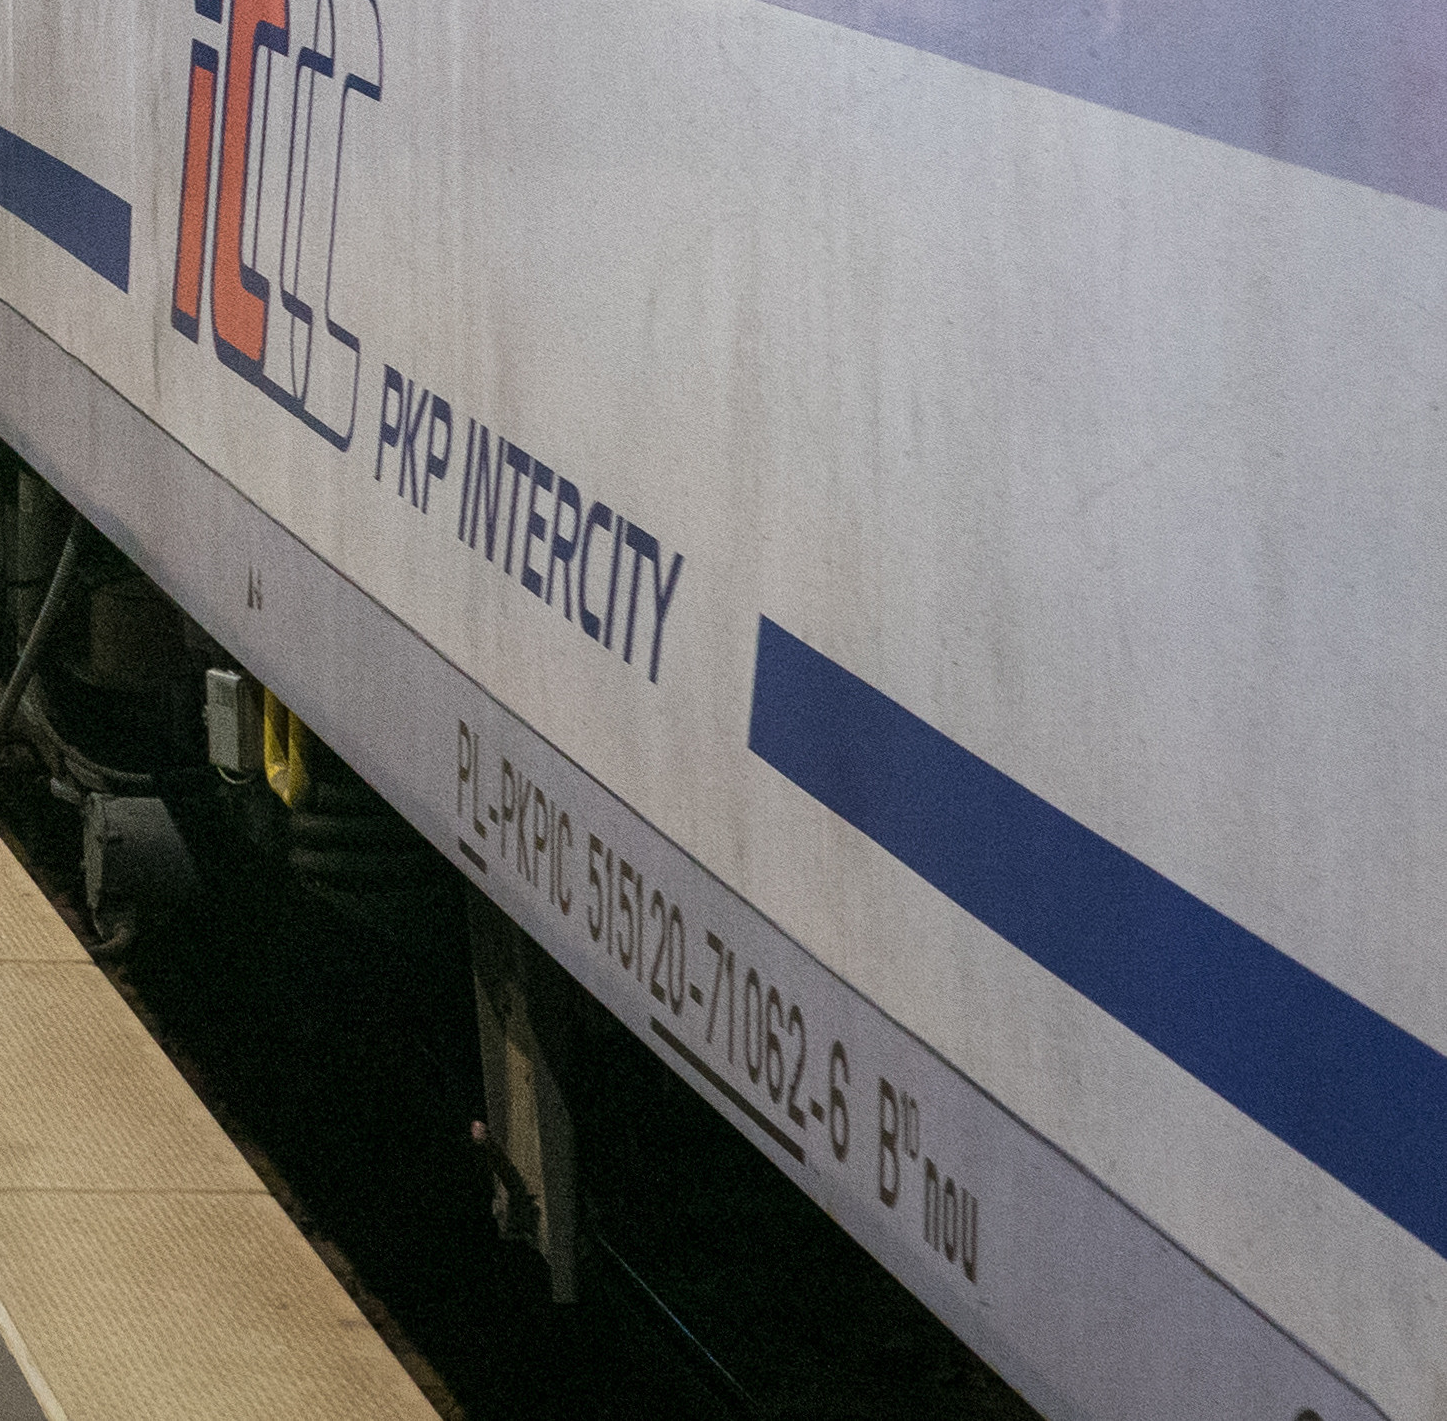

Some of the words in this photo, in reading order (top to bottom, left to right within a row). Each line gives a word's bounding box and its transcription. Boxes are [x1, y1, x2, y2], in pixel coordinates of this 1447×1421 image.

[373, 363, 453, 516] PKP
[458, 417, 684, 686] INTERCITY
[458, 717, 573, 917] PL-PKPIC
